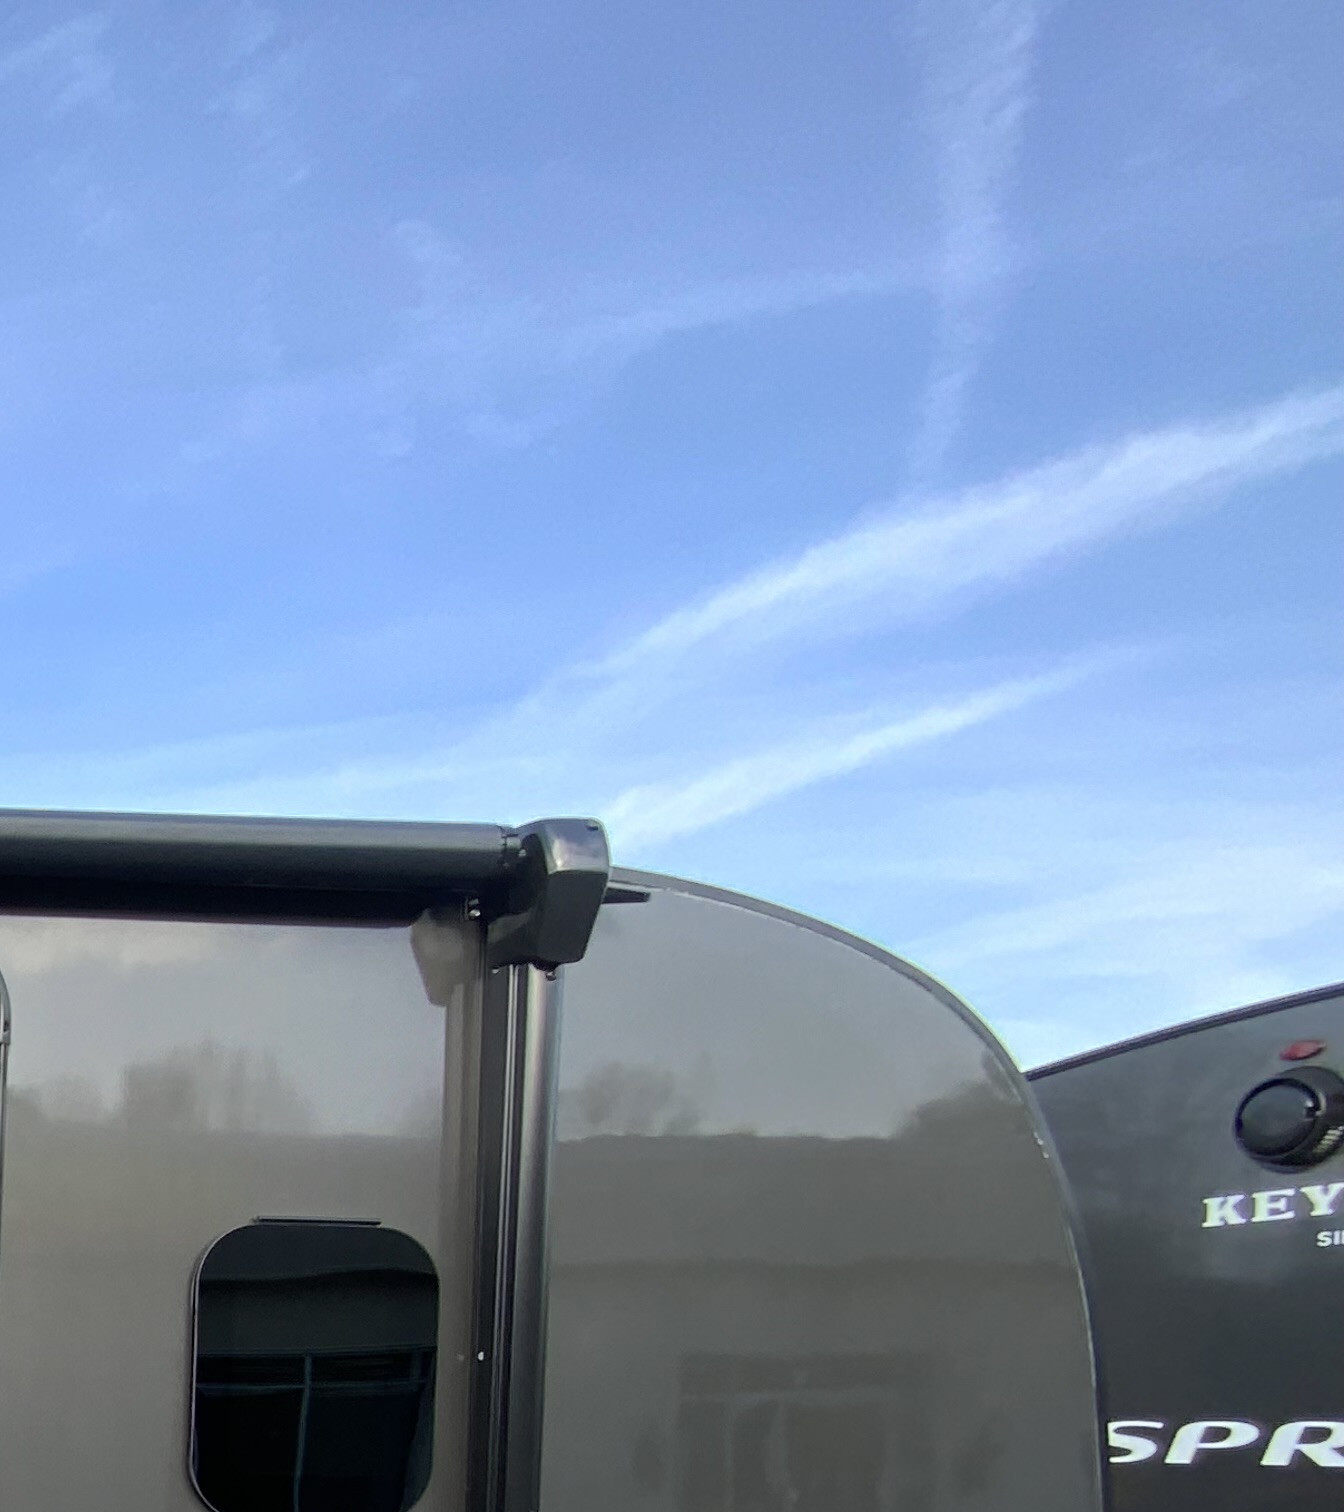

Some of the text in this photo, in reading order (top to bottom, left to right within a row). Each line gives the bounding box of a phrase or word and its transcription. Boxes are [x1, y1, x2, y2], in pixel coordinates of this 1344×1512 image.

[1201, 1182, 1344, 1228] KEY
[1316, 1229, 1344, 1248] SI
[1107, 1420, 1344, 1467] SPR
